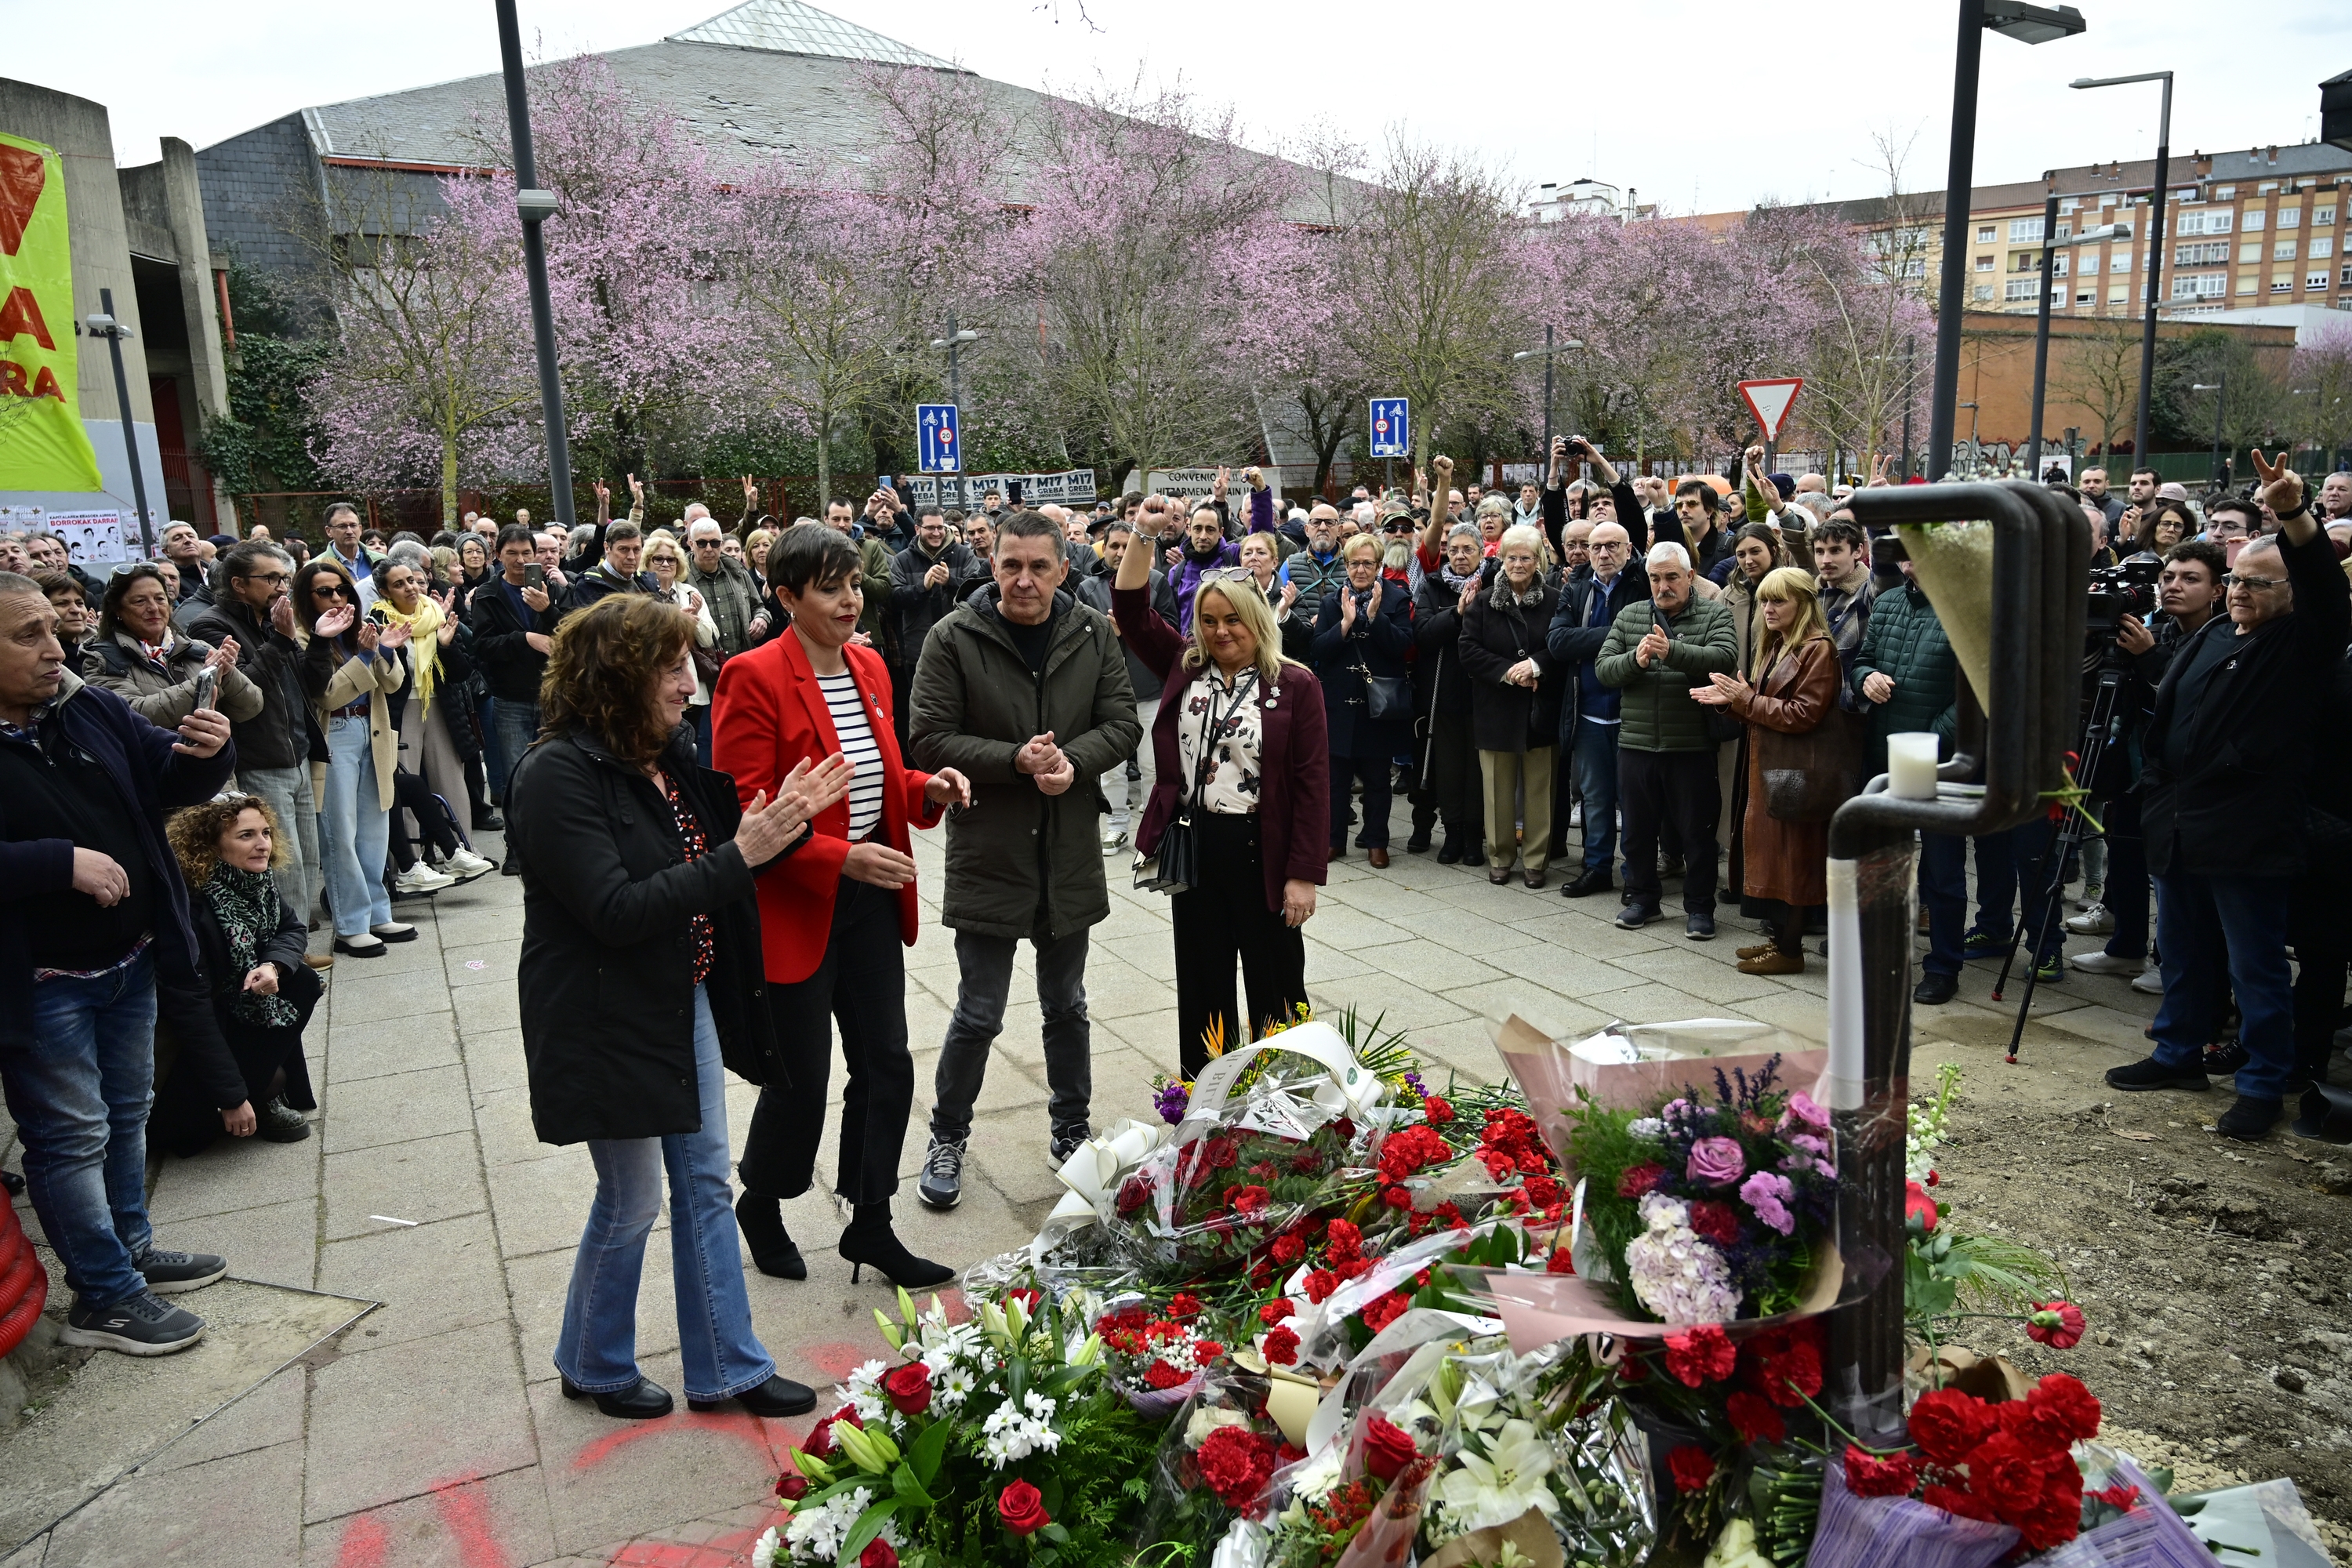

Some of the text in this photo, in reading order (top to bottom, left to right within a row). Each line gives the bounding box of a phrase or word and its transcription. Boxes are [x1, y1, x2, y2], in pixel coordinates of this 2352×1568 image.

[1036, 476, 1062, 488] M17
[1067, 473, 1092, 485] M17
[1168, 473, 1217, 482] CONVENIO
[906, 481, 933, 492] M17
[941, 481, 967, 491] M1
[972, 479, 999, 491] M17
